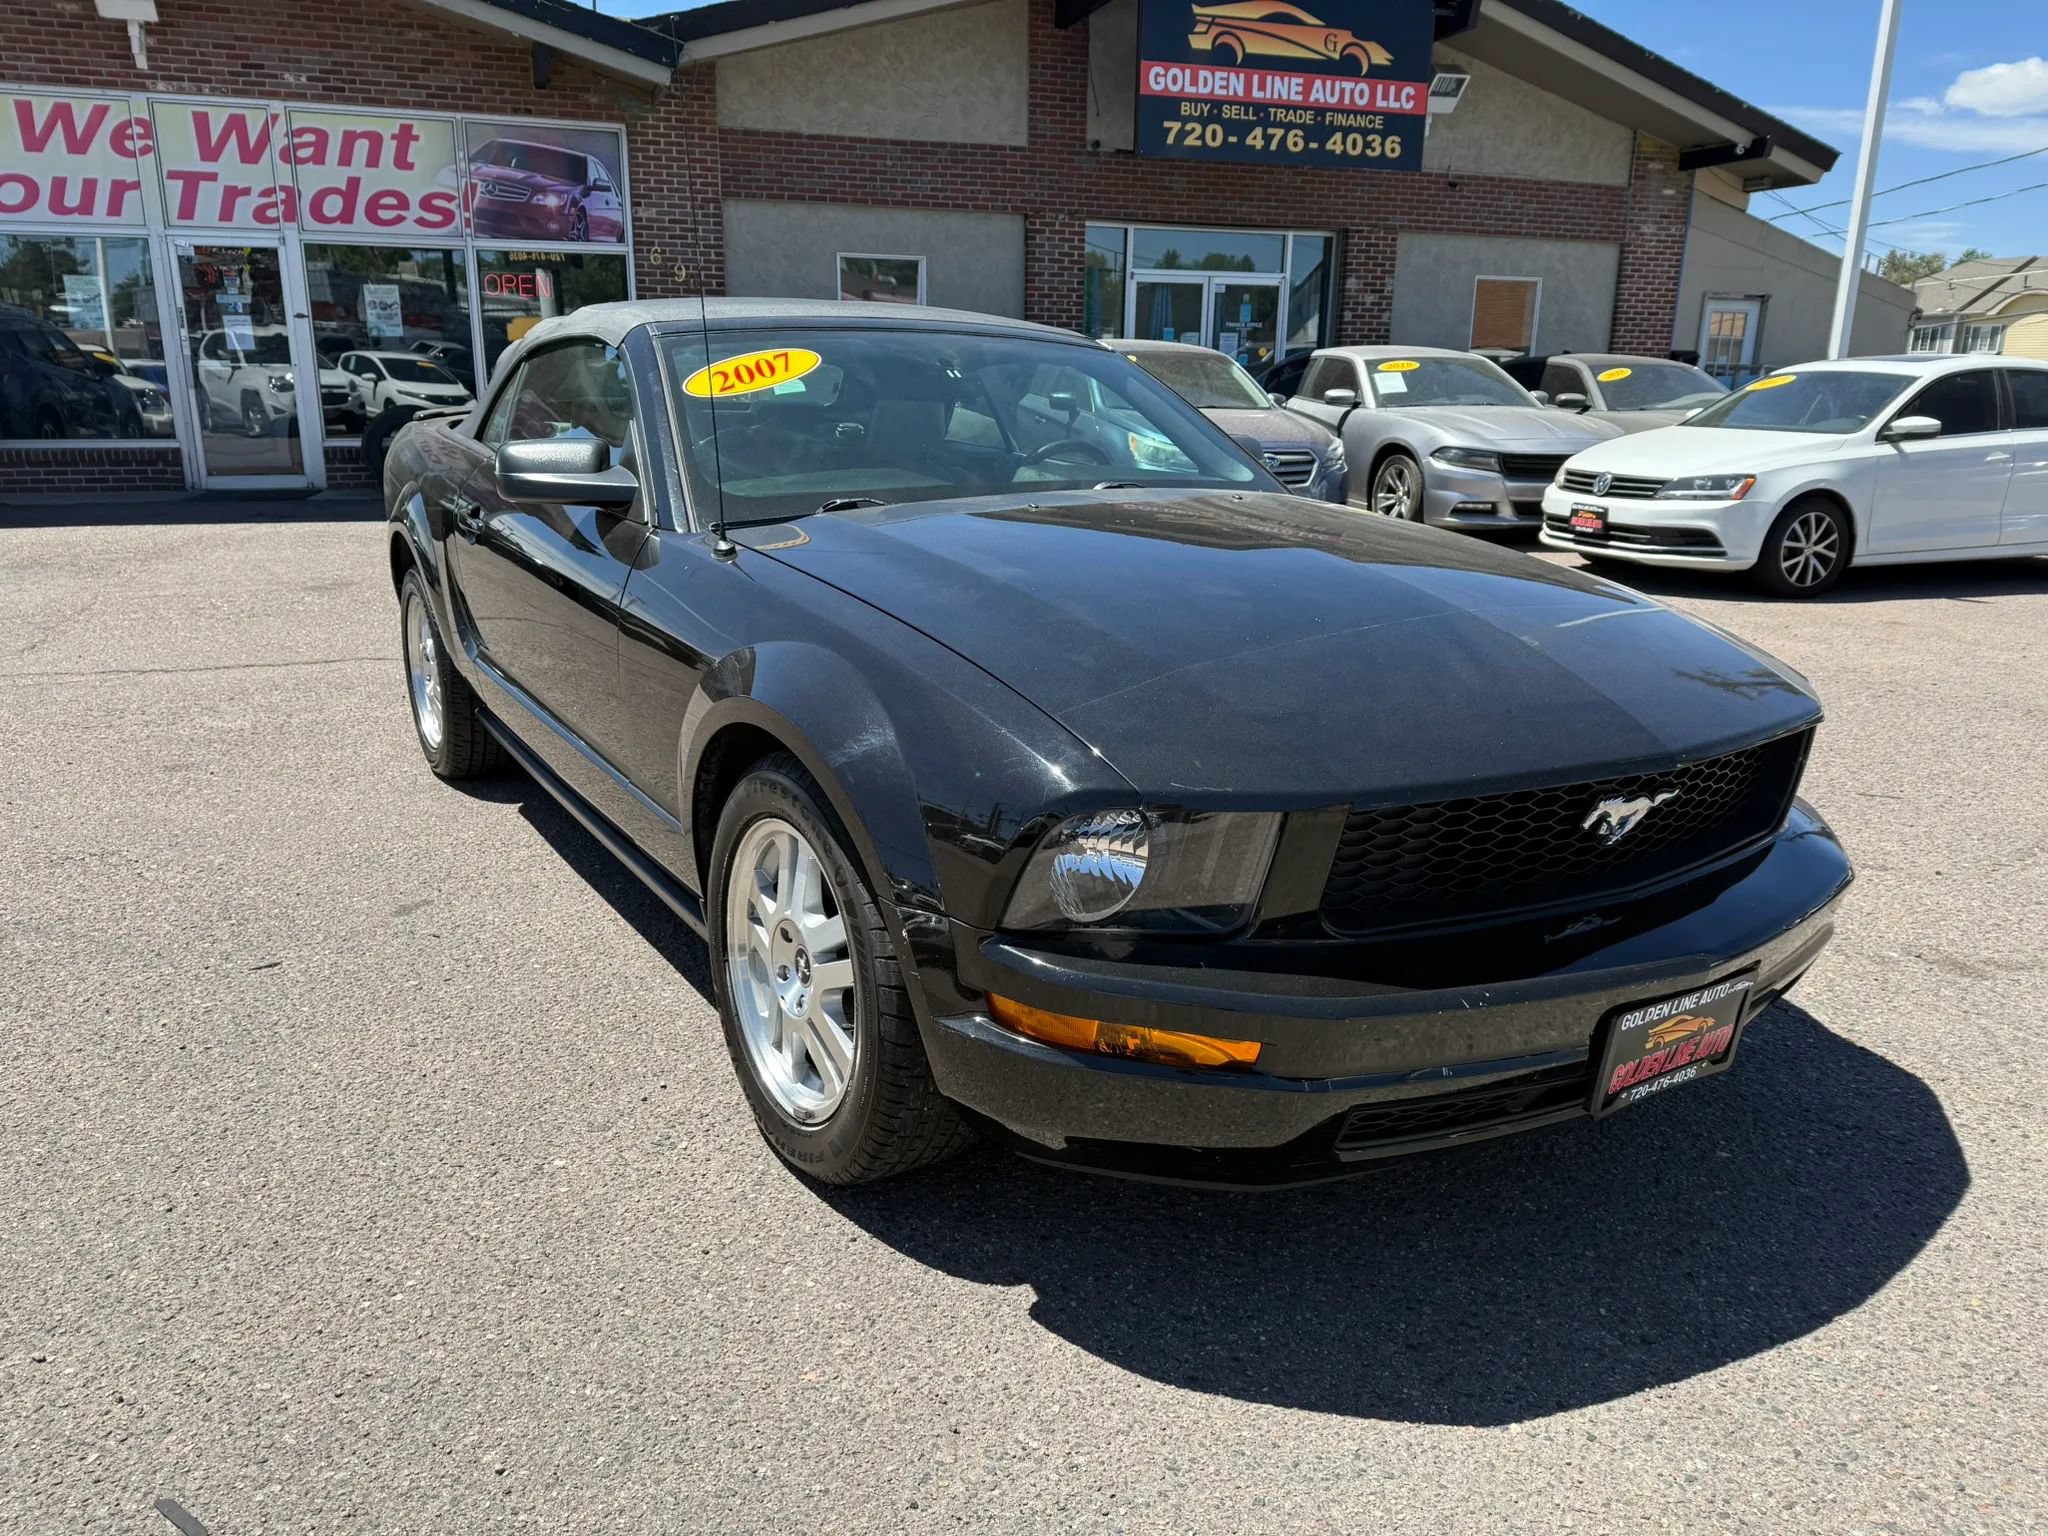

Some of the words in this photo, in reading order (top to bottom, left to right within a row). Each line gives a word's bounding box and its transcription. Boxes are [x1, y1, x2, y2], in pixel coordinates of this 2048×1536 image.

[1148, 65, 1245, 97] GOLDEN
[1251, 73, 1304, 102] LINE
[1309, 79, 1370, 107] AUTO
[1375, 84, 1416, 110] LLC
[12, 99, 154, 158] We
[191, 110, 420, 172] Want
[1180, 101, 1211, 117] BUY
[1221, 104, 1257, 120] SELL
[1268, 107, 1315, 125] TRADE
[1325, 112, 1384, 129] FINANCE
[165, 169, 480, 230] Trades!
[484, 273, 554, 298] OPEN
[711, 351, 790, 393] 2007
[1621, 1001, 1673, 1031] GOLDEN
[1671, 993, 1701, 1015] LINE
[1699, 983, 1731, 1006] AUTO
[1630, 1065, 1698, 1101] 720-476-4036
